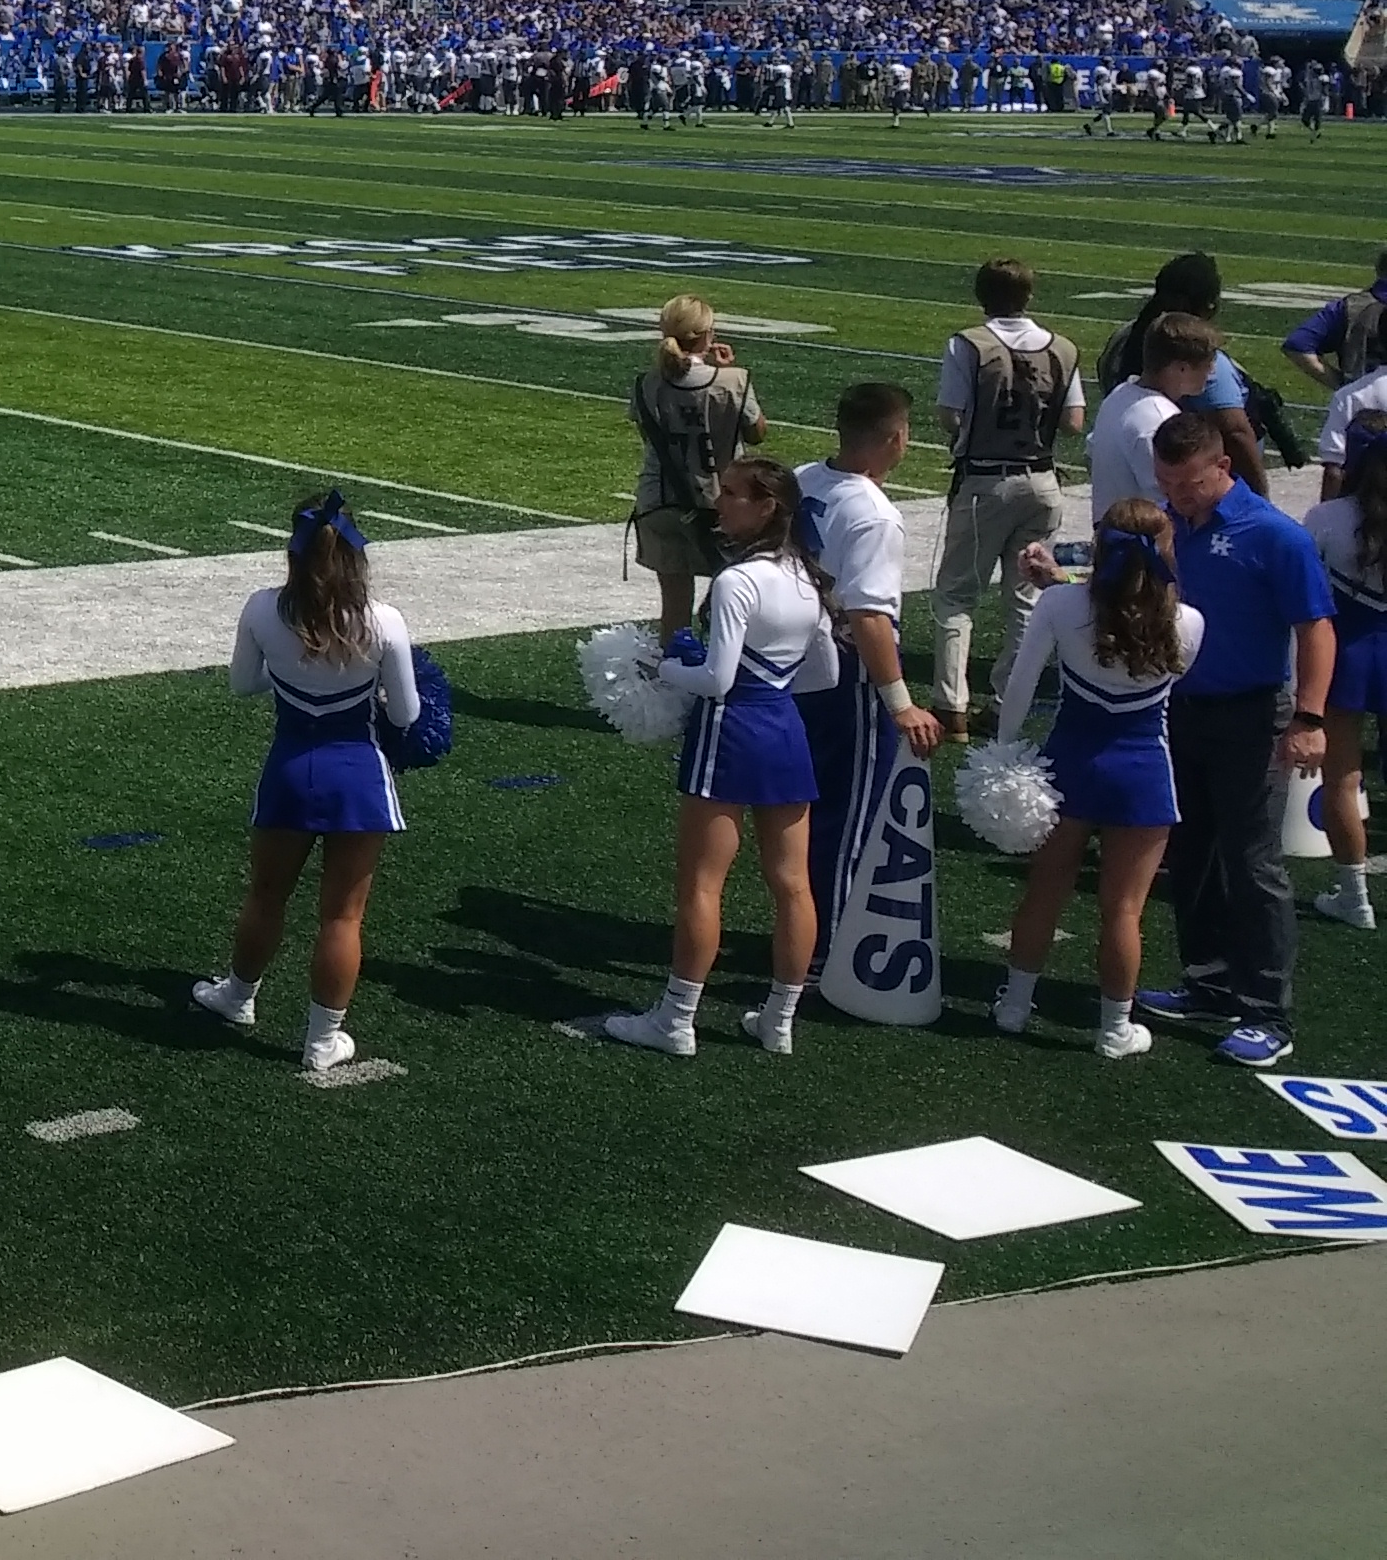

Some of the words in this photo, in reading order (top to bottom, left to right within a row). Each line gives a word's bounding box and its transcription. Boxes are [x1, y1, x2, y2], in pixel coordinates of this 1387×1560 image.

[62, 231, 731, 259] KROGER
[297, 248, 814, 277] FIELD
[853, 766, 933, 995] CATS
